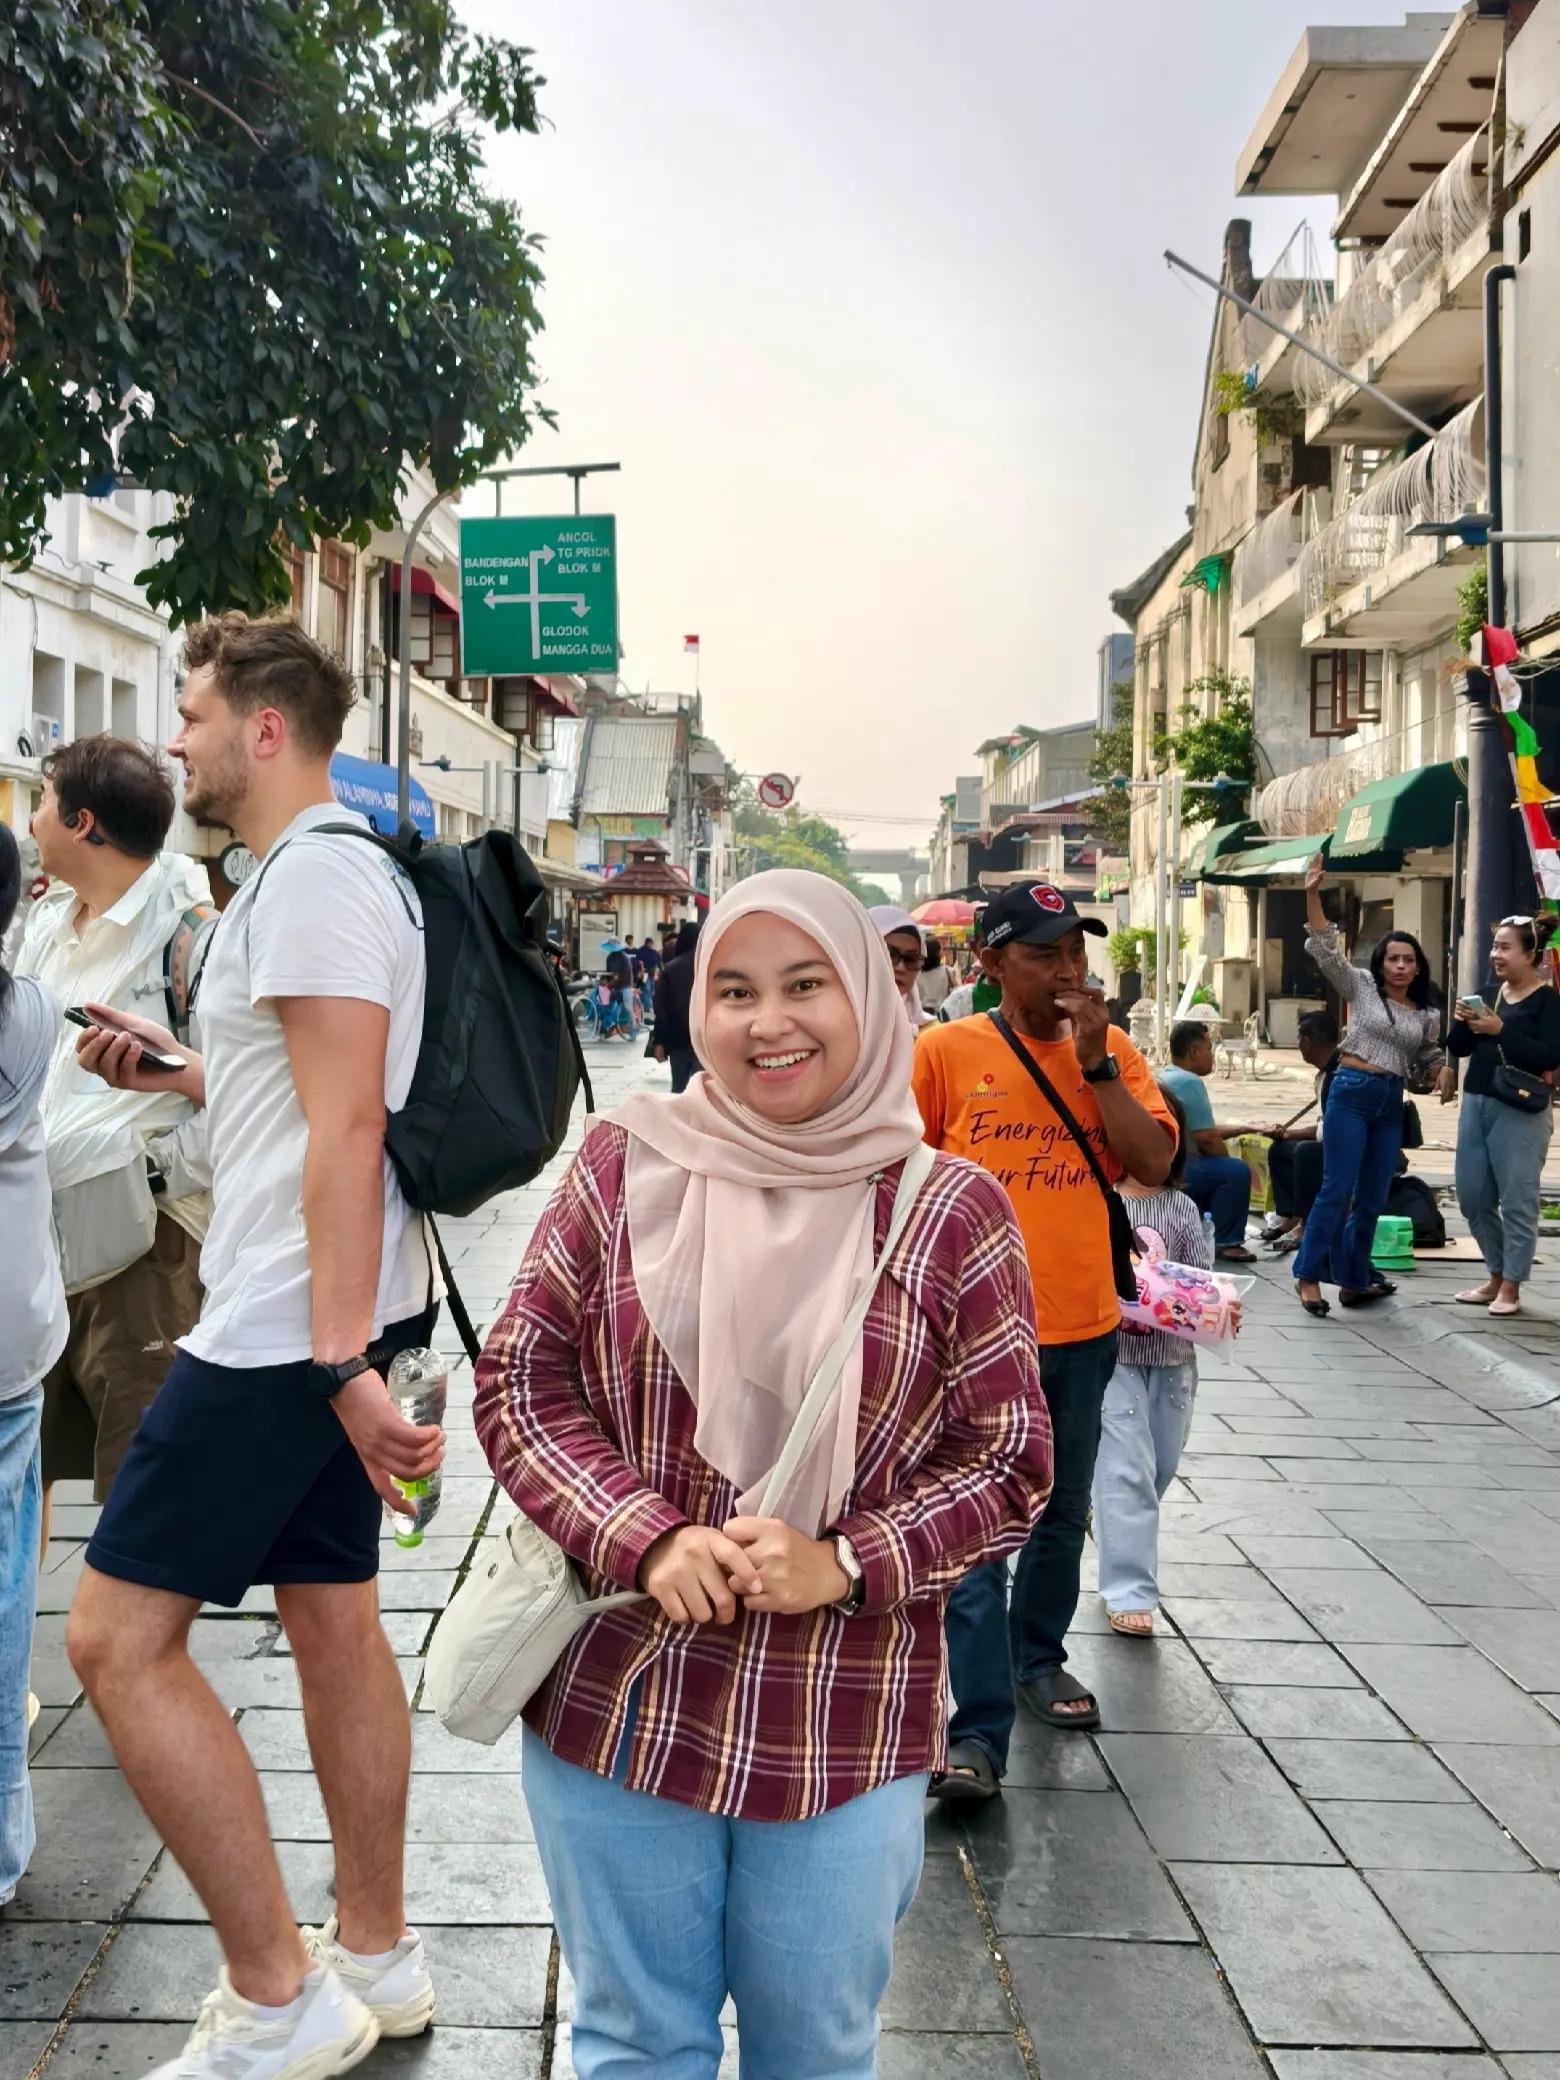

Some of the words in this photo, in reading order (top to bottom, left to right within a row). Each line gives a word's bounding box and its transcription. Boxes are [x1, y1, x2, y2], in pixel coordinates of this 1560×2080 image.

[558, 532, 596, 542] ANCOL
[464, 557, 528, 568] BANDENGAN
[558, 564, 588, 574] BLOK
[465, 576, 495, 586] BLOK
[542, 626, 588, 636] GLODOK
[542, 644, 588, 655] MANGGA
[591, 644, 612, 655] DUA
